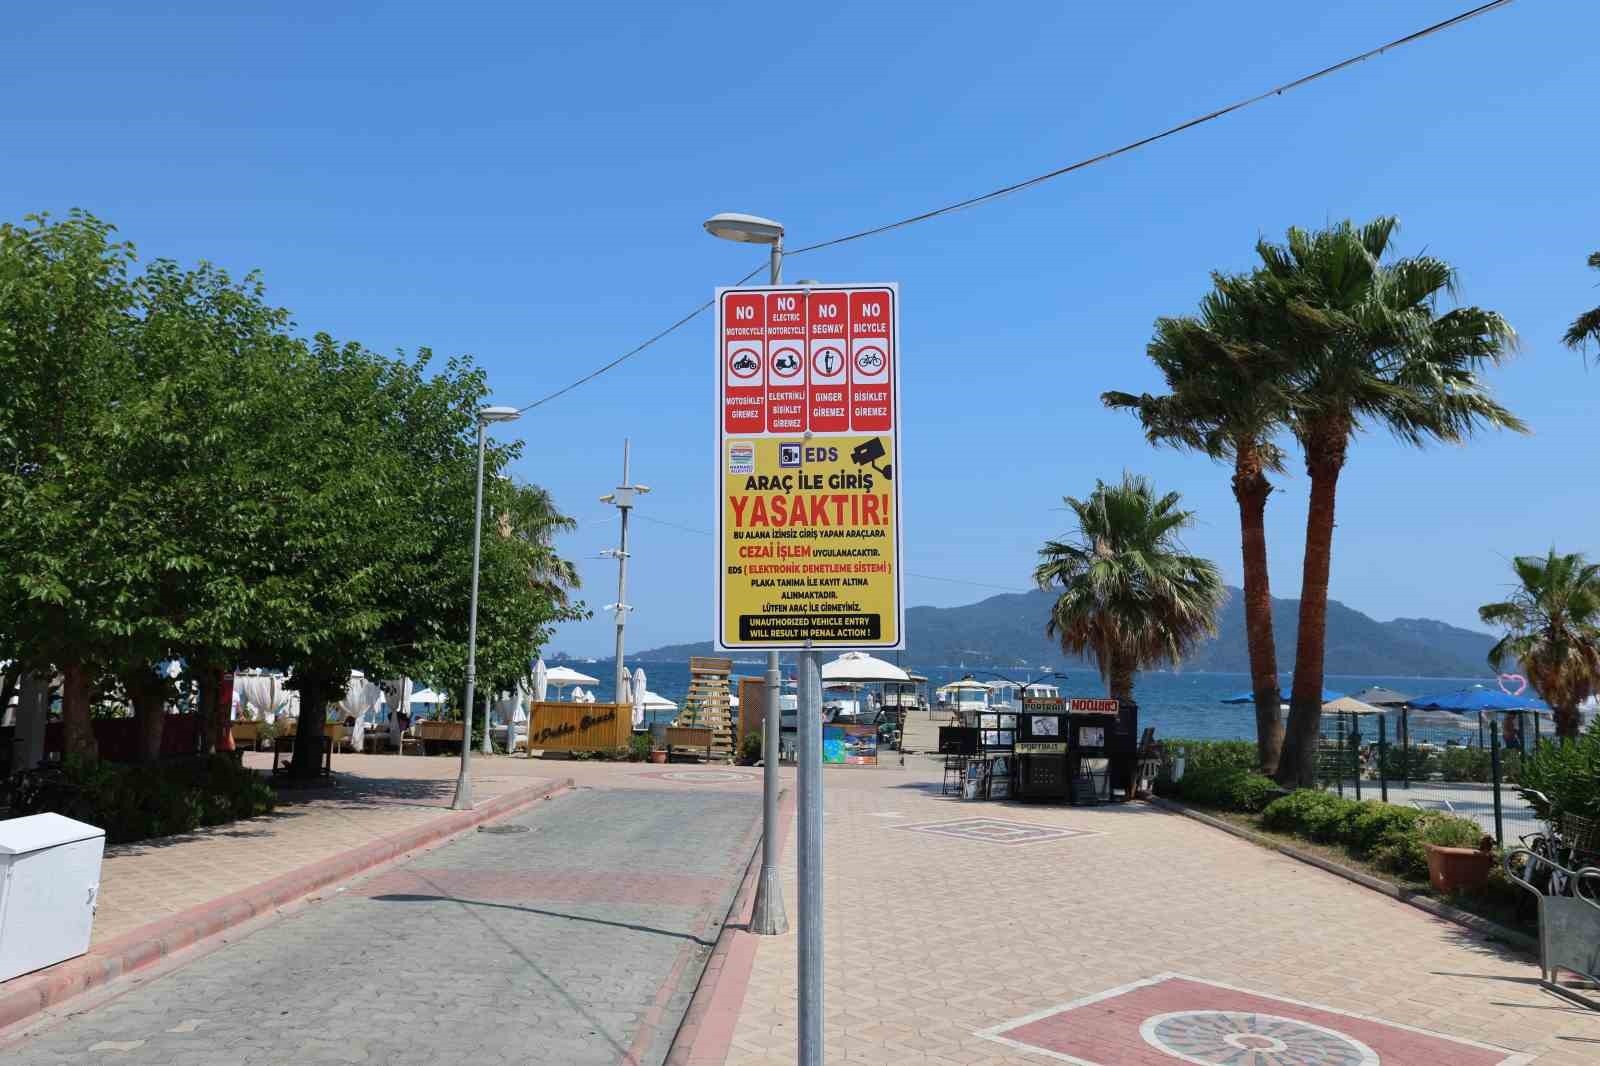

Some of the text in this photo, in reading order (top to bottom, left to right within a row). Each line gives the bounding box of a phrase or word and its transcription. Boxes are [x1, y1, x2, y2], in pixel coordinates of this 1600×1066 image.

[777, 298, 795, 311] NO
[736, 306, 754, 319] NO
[819, 304, 837, 318] NO
[862, 304, 880, 317] NO
[726, 327, 764, 335] MOTORCYCLE
[768, 327, 805, 335] MOTORCYCLE
[812, 324, 843, 334] SEGWAY
[854, 323, 886, 333] BICYCLE
[855, 392, 887, 401] BİSİKLET
[732, 410, 759, 418] GİREMEZ
[773, 405, 800, 414] BİSİKLET
[813, 407, 844, 416] GİREMEZ
[855, 407, 887, 416] GİREMEZ
[773, 419, 800, 428] GİREMEZ
[806, 447, 838, 463] EDS
[745, 469, 873, 494] ARAÇ İLE GİRİŞ
[730, 494, 888, 528] YASAKTIR!
[734, 529, 885, 540] BU ALANA İZİNSİZ GİRİŞ YAPAN ARAÇLARA
[739, 541, 880, 560] CEZAİ İŞLEM UYGULANACAKTIR.
[728, 566, 742, 574] EDS
[749, 563, 800, 573] ELEKTRONİK
[802, 564, 854, 573] DENETLEME
[855, 562, 887, 572] SİSTEMİ
[752, 577, 868, 587] PLAKA TANIMA İLE KAYIT ALTINA
[781, 591, 838, 599] ALINMAKTADIR.
[763, 602, 861, 614] LÜTFEN ARAÇ İLE GİRMEYİNİZ.
[750, 617, 870, 626] UNAUTHORIZED VEHICLE ENTRY
[750, 630, 769, 638] WILL
[771, 629, 798, 637] RESULT
[801, 629, 808, 637] IN
[810, 629, 835, 637] PENAL
